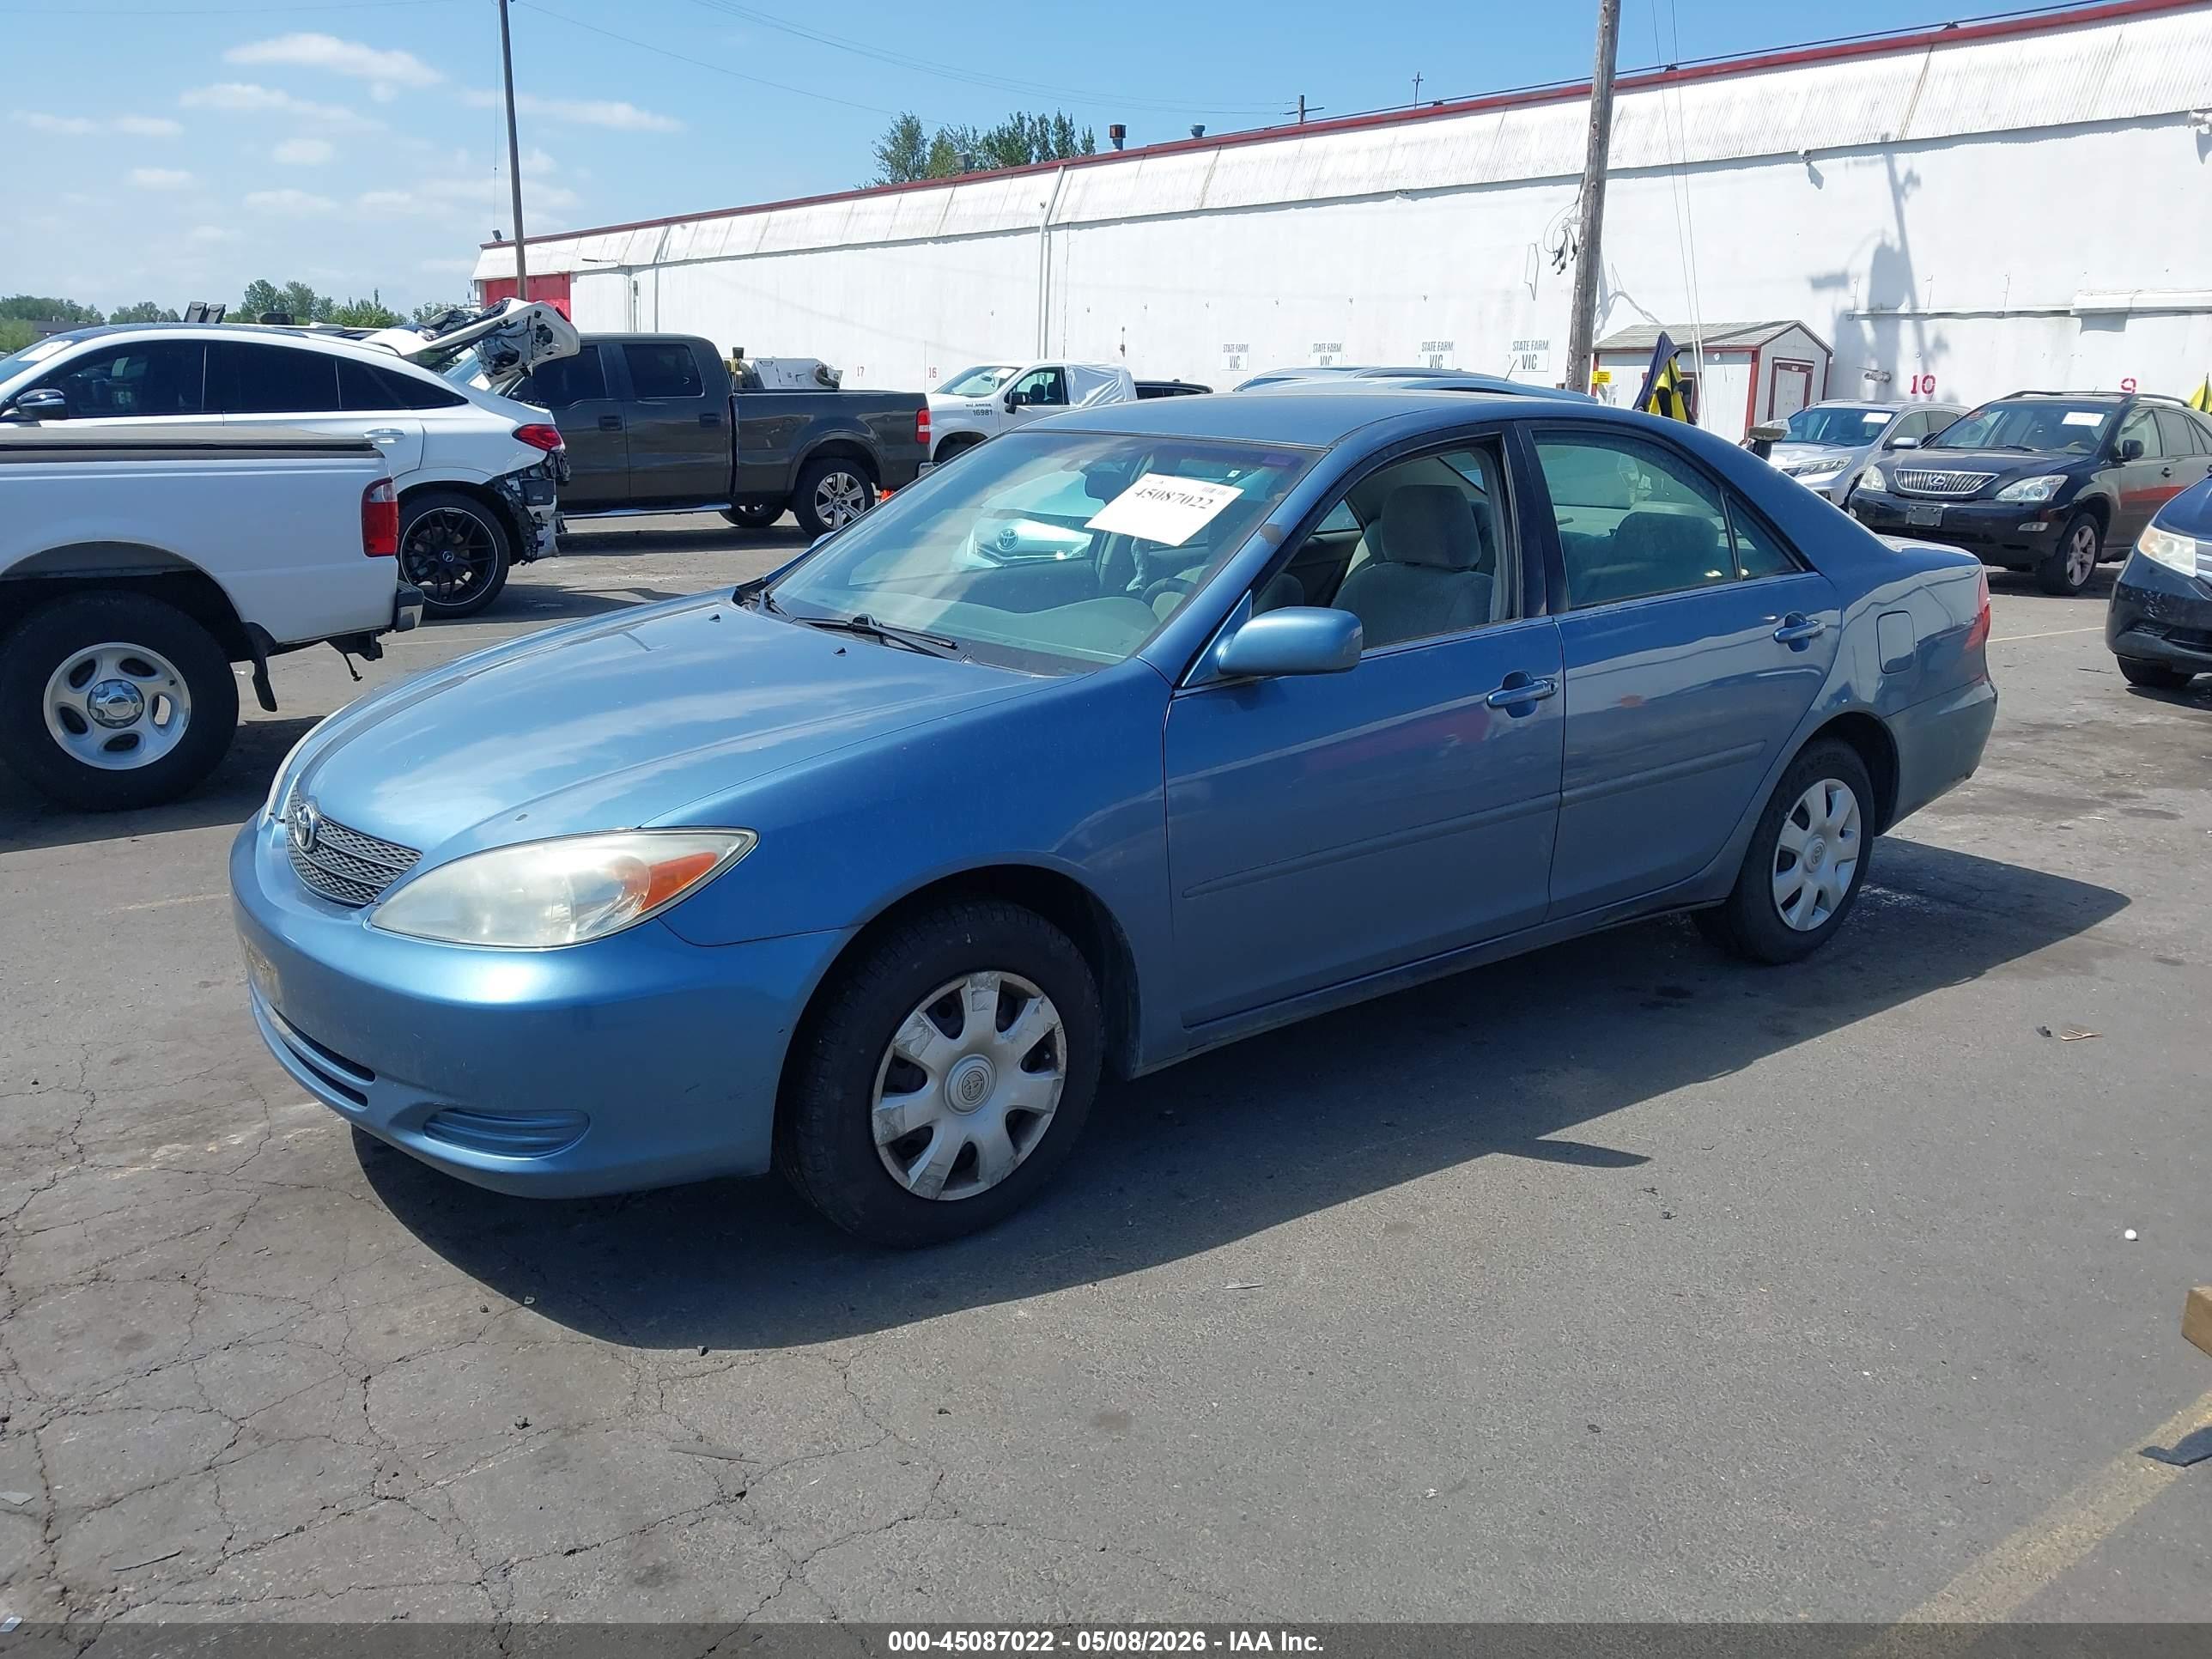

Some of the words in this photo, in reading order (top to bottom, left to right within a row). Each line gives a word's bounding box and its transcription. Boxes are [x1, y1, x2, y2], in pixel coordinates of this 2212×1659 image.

[1223, 343, 1235, 353] STATE
[1236, 343, 1249, 353] FARM
[1313, 343, 1326, 353] STATE
[1327, 343, 1341, 353] FARM
[1421, 341, 1437, 352] STATE
[1437, 341, 1454, 351] FARM
[1512, 340, 1530, 351] STATE
[1531, 340, 1549, 351] FARM
[1229, 356, 1241, 369] VIC
[1429, 354, 1443, 369] VIC
[1522, 354, 1537, 370] VIC
[857, 366, 865, 378] 17
[928, 367, 937, 379] 16
[1911, 374, 1936, 395] 10
[2120, 378, 2137, 393] 9
[1134, 487, 1214, 509] 45087022
